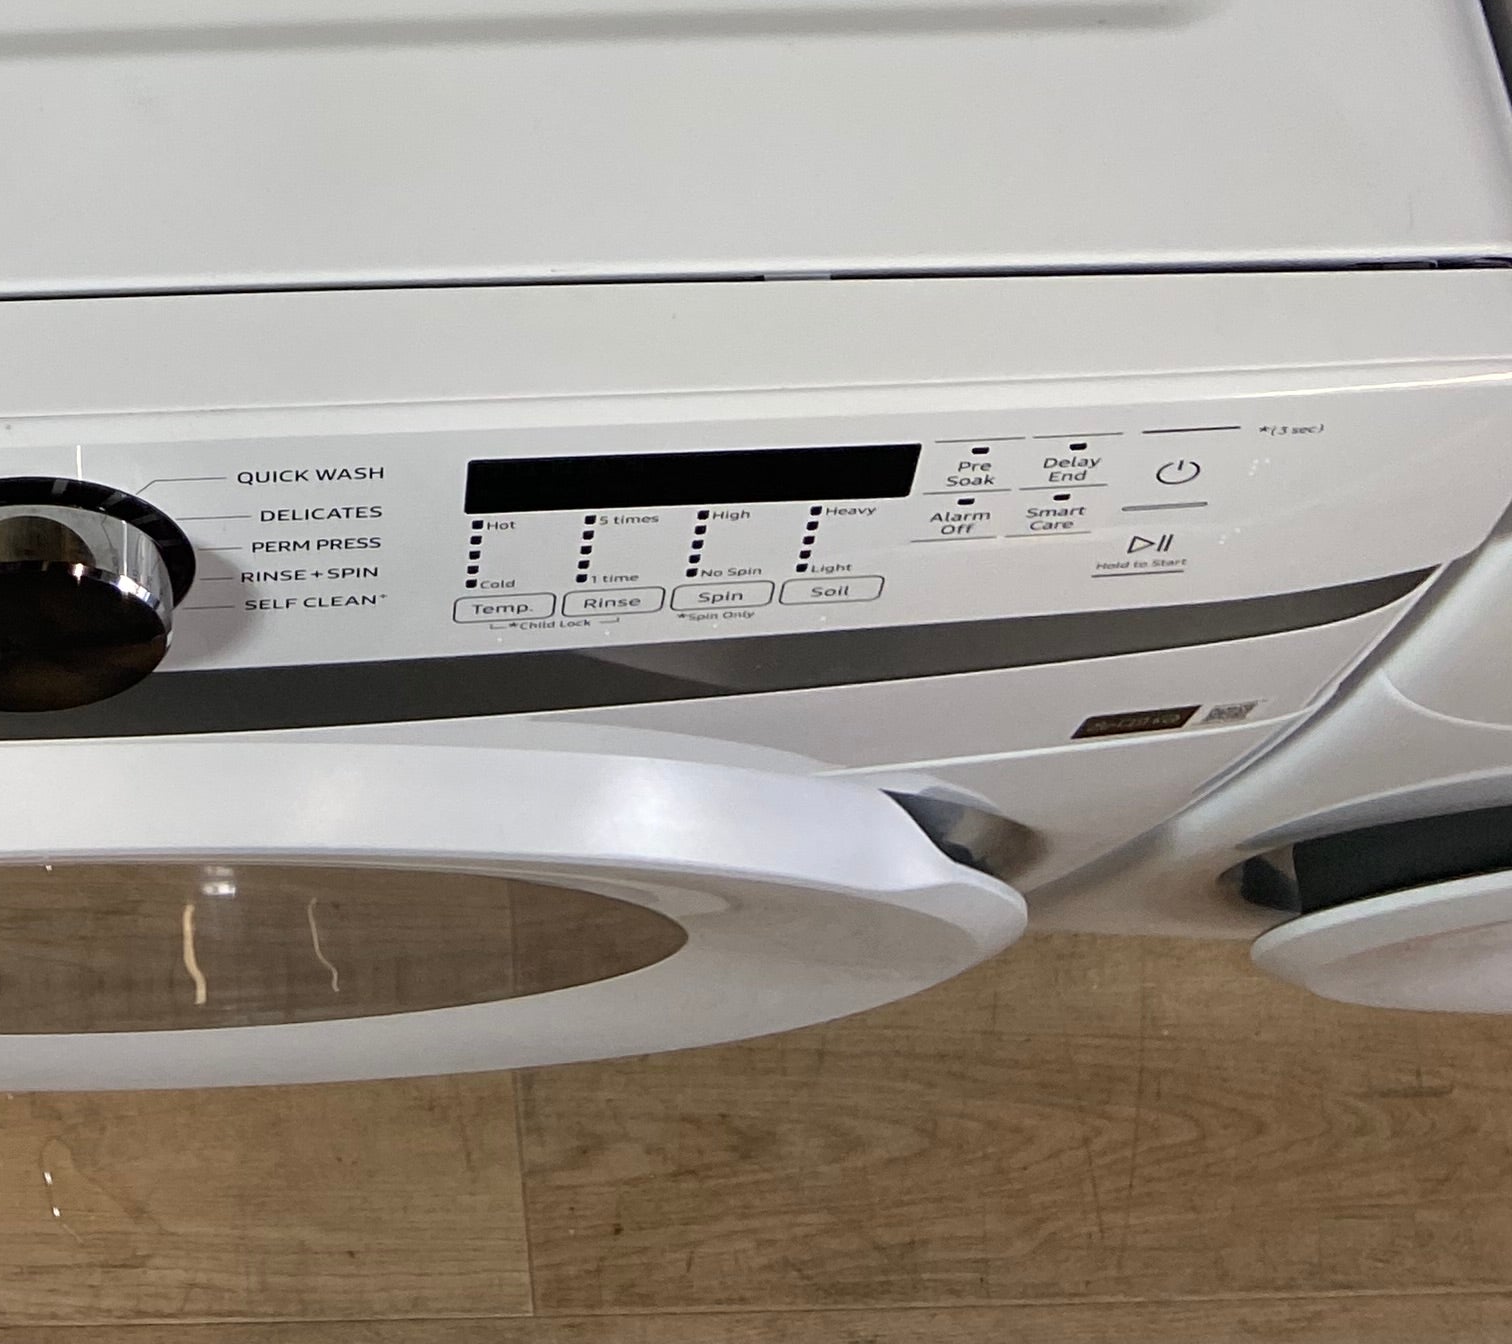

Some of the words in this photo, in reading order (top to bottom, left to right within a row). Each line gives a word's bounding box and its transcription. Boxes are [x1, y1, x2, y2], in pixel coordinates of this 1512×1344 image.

[958, 461, 992, 472] Pre
[1043, 457, 1101, 469] Delay
[237, 470, 309, 486] QUICK
[316, 467, 384, 481] WASH
[946, 475, 996, 487] Soak
[1049, 470, 1087, 482] End
[260, 506, 383, 522] DELICATES
[712, 510, 751, 521] High
[826, 506, 877, 516] Heavy
[1026, 506, 1086, 518] Smart
[599, 516, 609, 526] 5
[614, 514, 660, 524] times
[930, 512, 991, 522] Alarm
[487, 521, 516, 530] Hot
[941, 524, 974, 535] Off
[1030, 520, 1074, 531] Care
[252, 540, 310, 553] PERM
[316, 537, 382, 550] PRESS
[811, 564, 853, 574] Light
[1096, 562, 1129, 570] Hold
[1152, 559, 1187, 567] Start
[241, 570, 307, 582] RINSE
[327, 566, 379, 579] SPIN
[700, 569, 723, 577] No
[728, 567, 762, 577] Spin
[480, 579, 516, 589] Cold
[602, 574, 639, 583] time
[810, 585, 850, 598] Soil
[583, 596, 642, 609] Rinse
[698, 590, 743, 605] Spin
[245, 598, 298, 611] SELF
[472, 602, 534, 616] Temp.
[722, 610, 755, 620] Only
[559, 619, 591, 628] Lock
